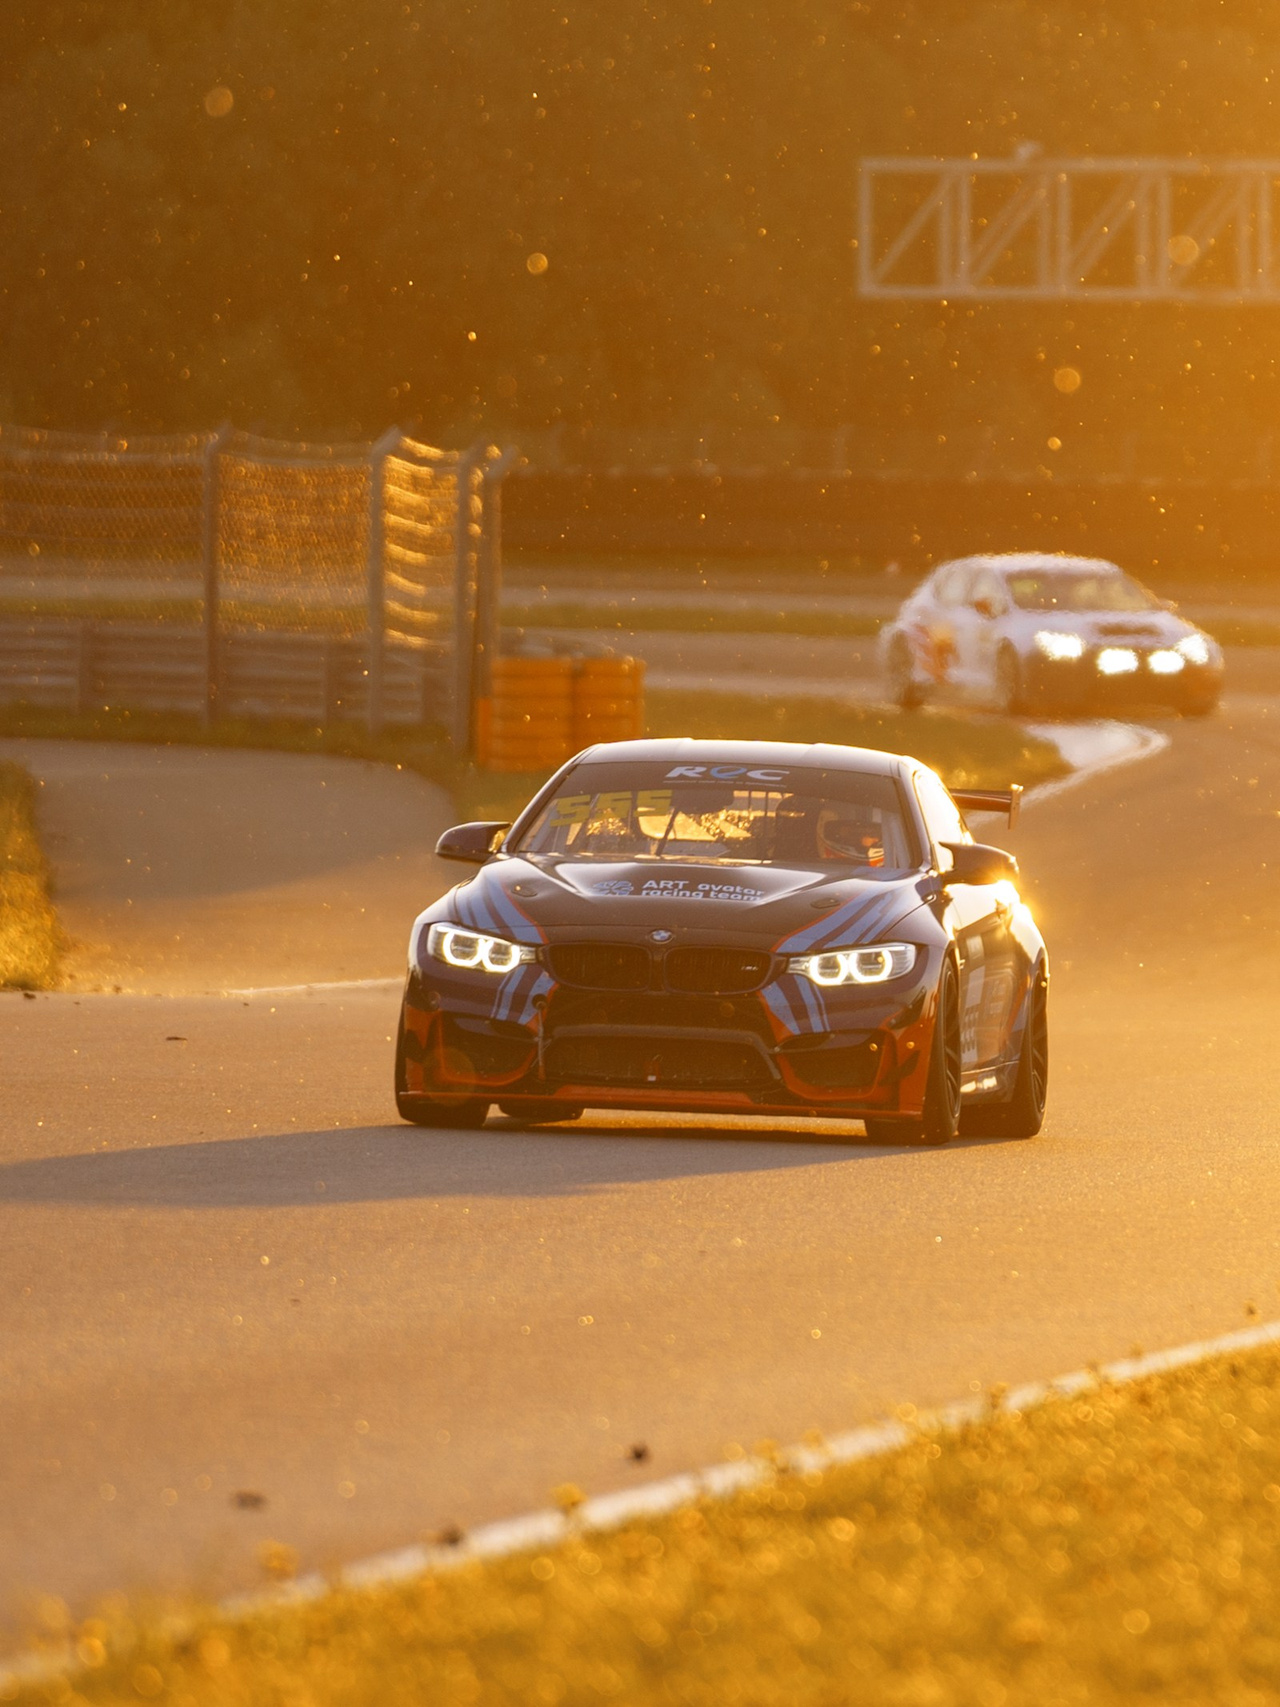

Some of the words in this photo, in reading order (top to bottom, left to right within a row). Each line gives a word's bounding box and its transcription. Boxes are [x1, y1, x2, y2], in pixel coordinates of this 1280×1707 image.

[549, 789, 674, 827] 555
[641, 889, 703, 898] racing
[709, 891, 761, 901] team
[643, 880, 689, 889] ART
[697, 883, 764, 896] avatar
